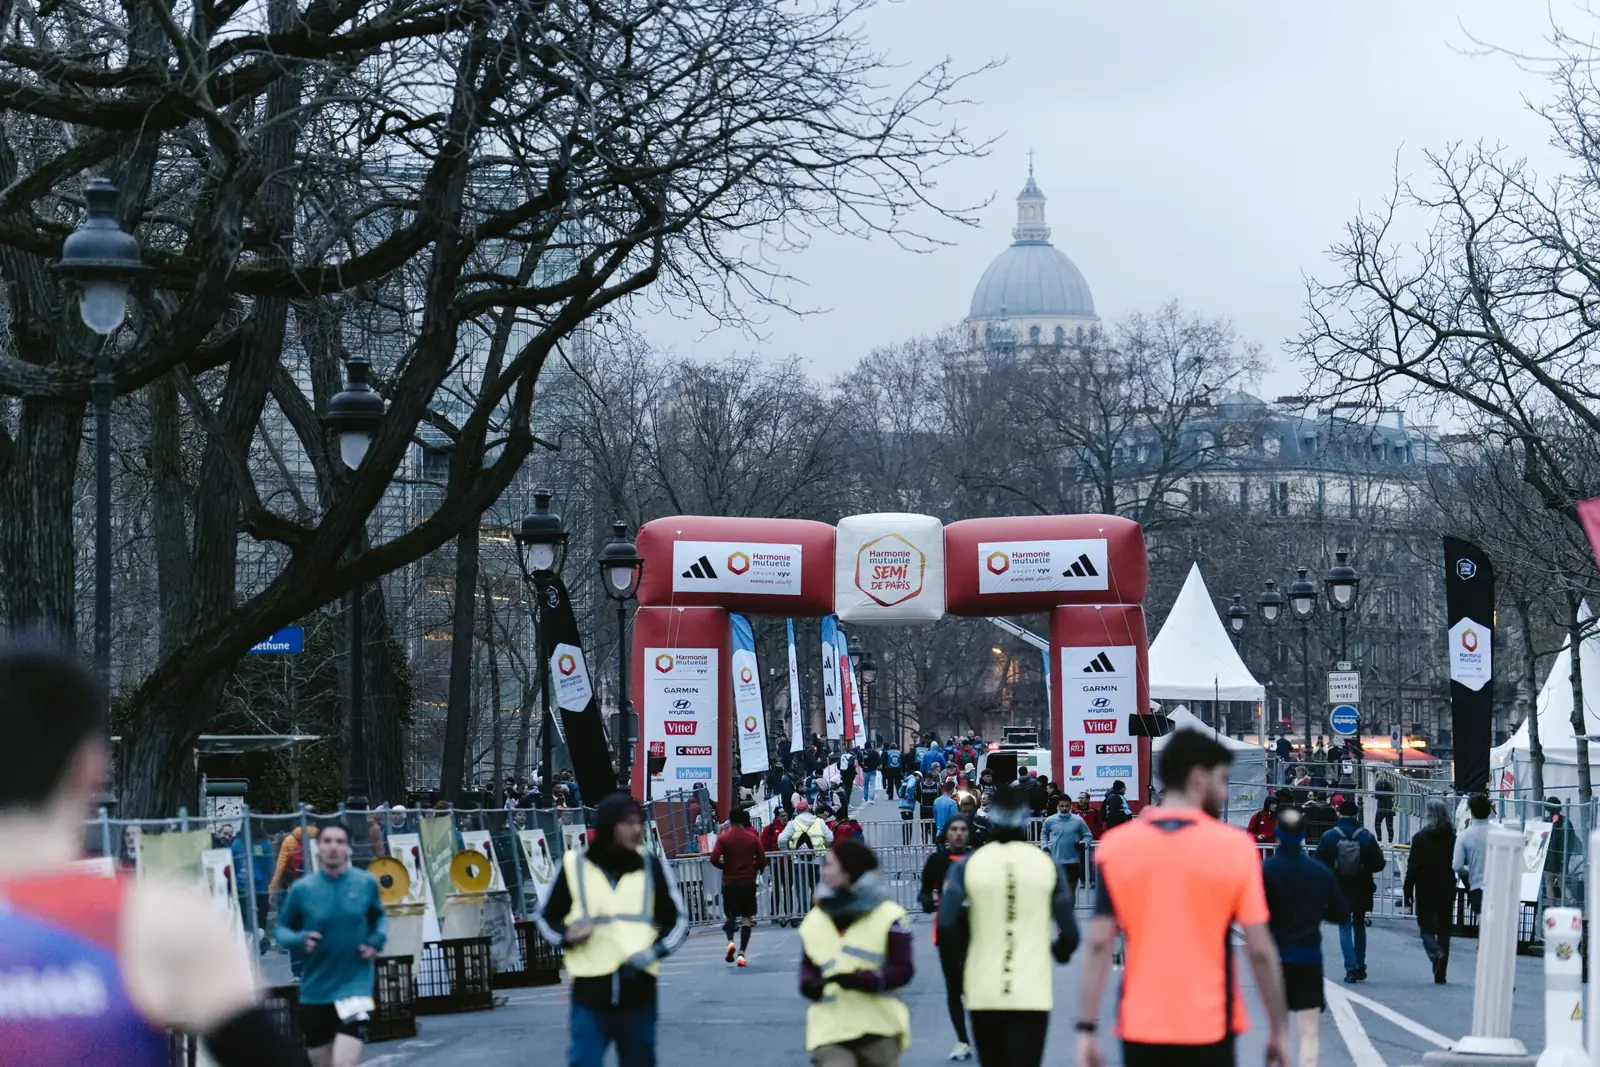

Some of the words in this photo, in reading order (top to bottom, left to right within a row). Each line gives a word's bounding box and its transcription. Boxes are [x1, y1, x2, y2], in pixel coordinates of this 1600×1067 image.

[752, 553, 790, 561] Harmonie
[870, 582, 883, 590] DE
[667, 722, 694, 733] Vittel
[1086, 721, 1114, 732] Vittel
[686, 768, 710, 778] Parisien
[1106, 767, 1129, 776] Parisien
